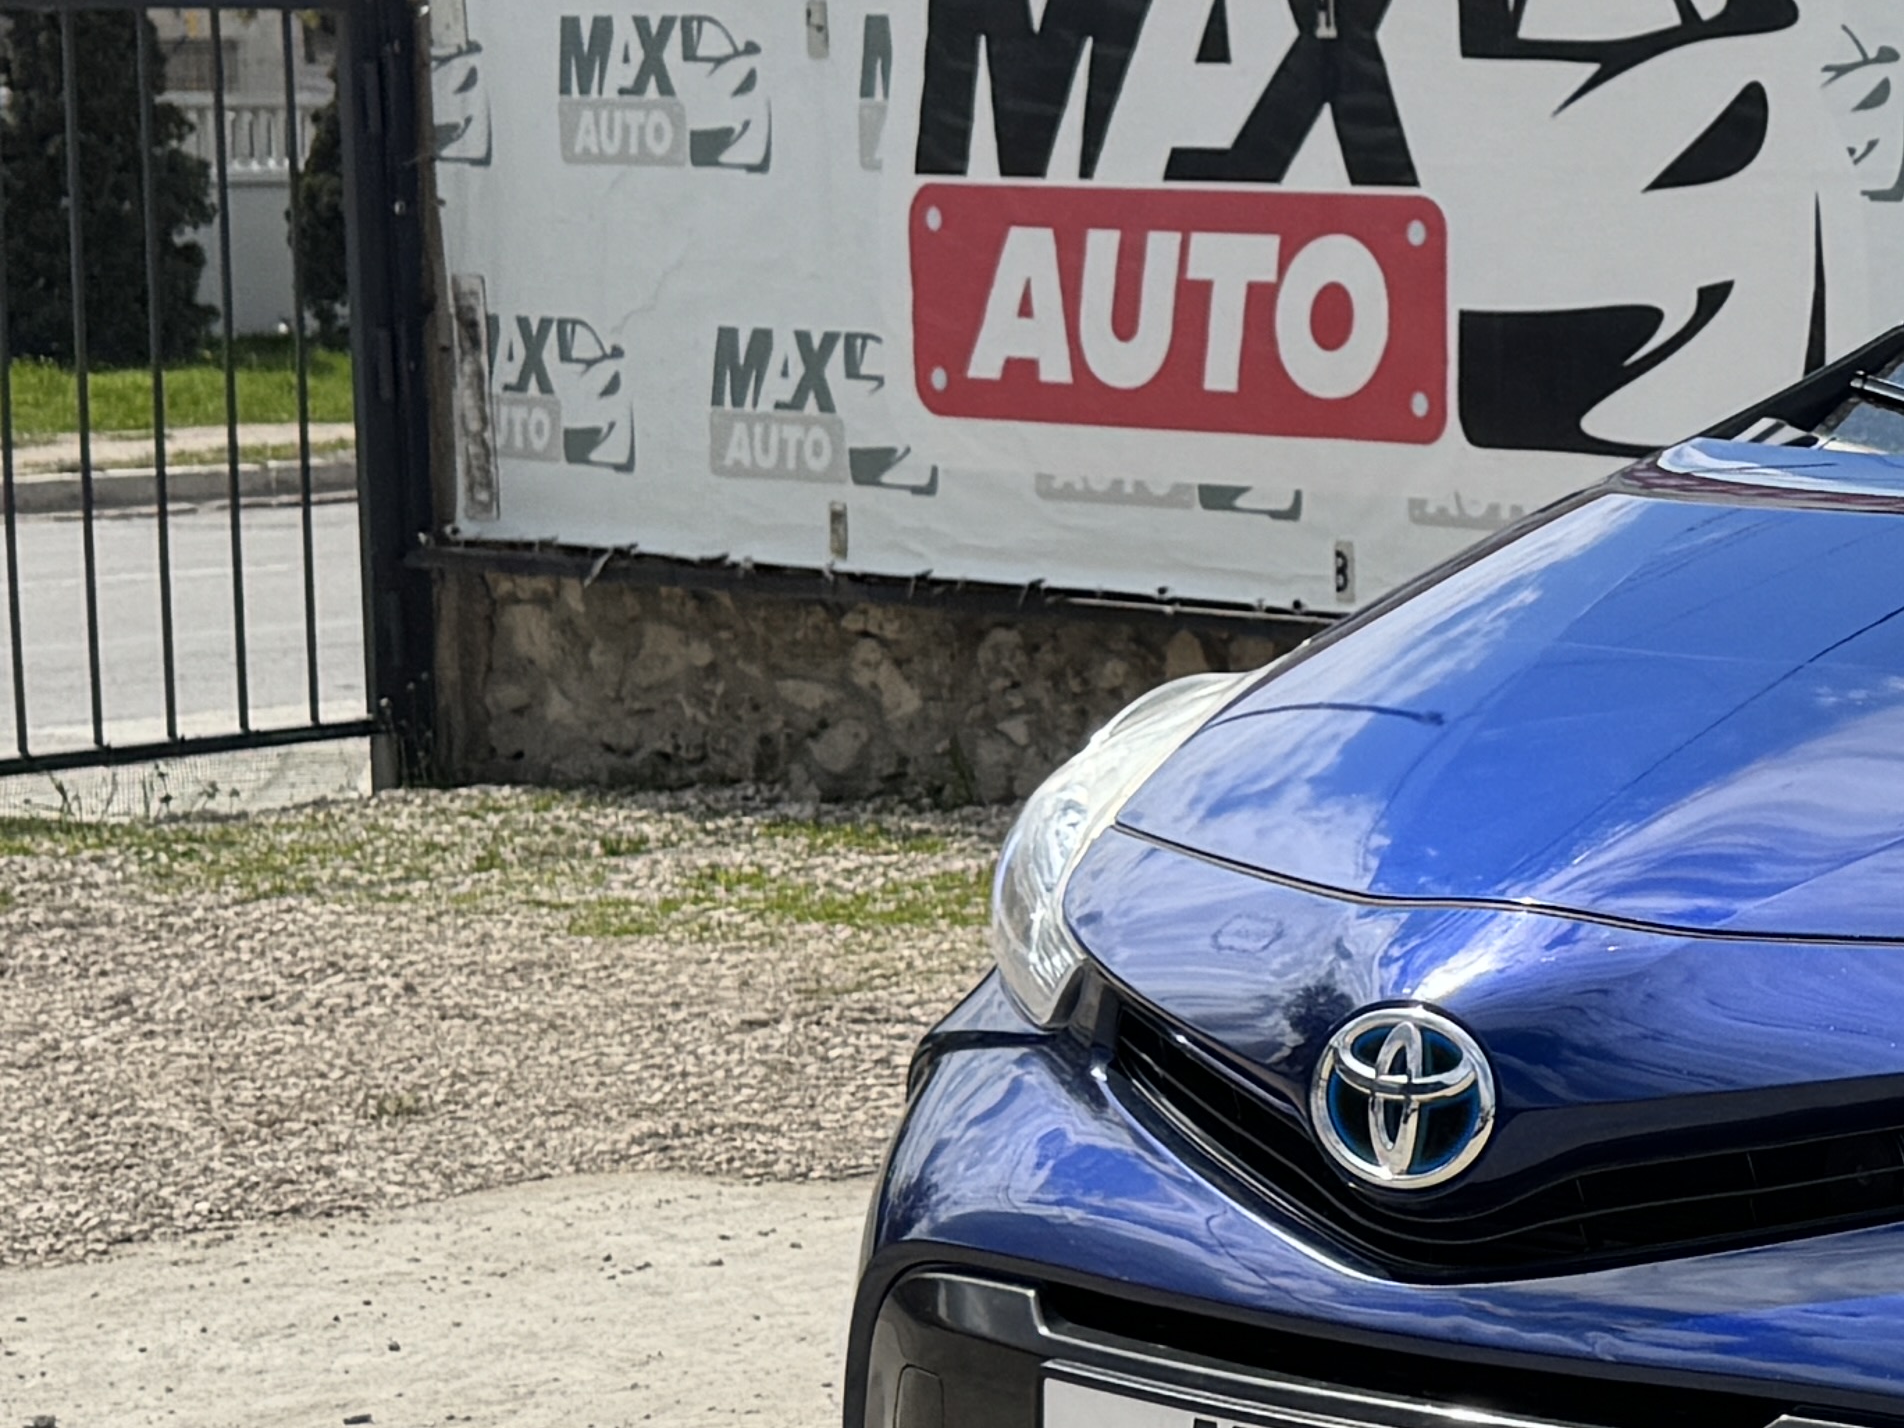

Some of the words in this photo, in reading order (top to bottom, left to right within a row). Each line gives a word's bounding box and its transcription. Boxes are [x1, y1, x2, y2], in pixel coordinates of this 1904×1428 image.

[559, 14, 678, 98] MAX
[573, 109, 673, 156] AUTO
[966, 224, 1389, 398] AUTO
[711, 326, 842, 414] MAX
[723, 419, 833, 470] AUTO
